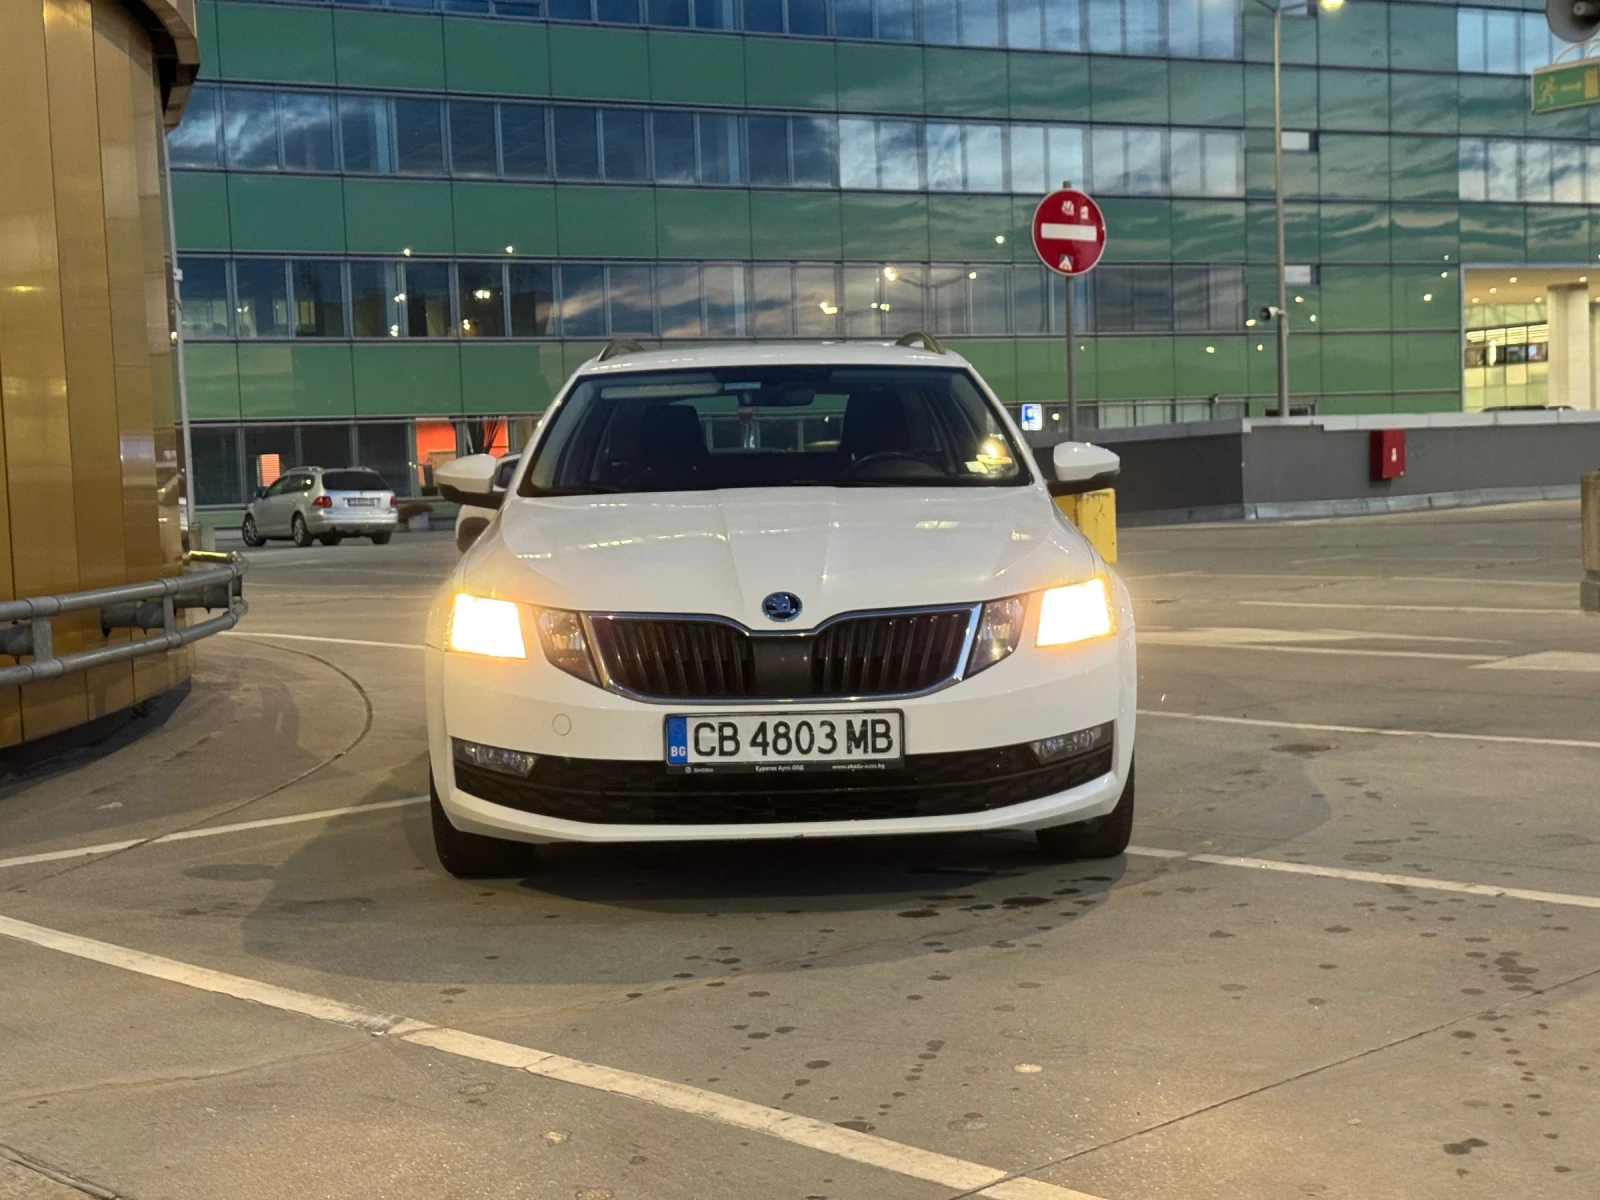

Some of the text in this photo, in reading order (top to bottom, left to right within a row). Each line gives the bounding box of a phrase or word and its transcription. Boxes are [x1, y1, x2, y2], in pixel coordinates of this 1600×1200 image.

[694, 718, 893, 757] CB 4803 MB
[670, 746, 686, 757] BG
